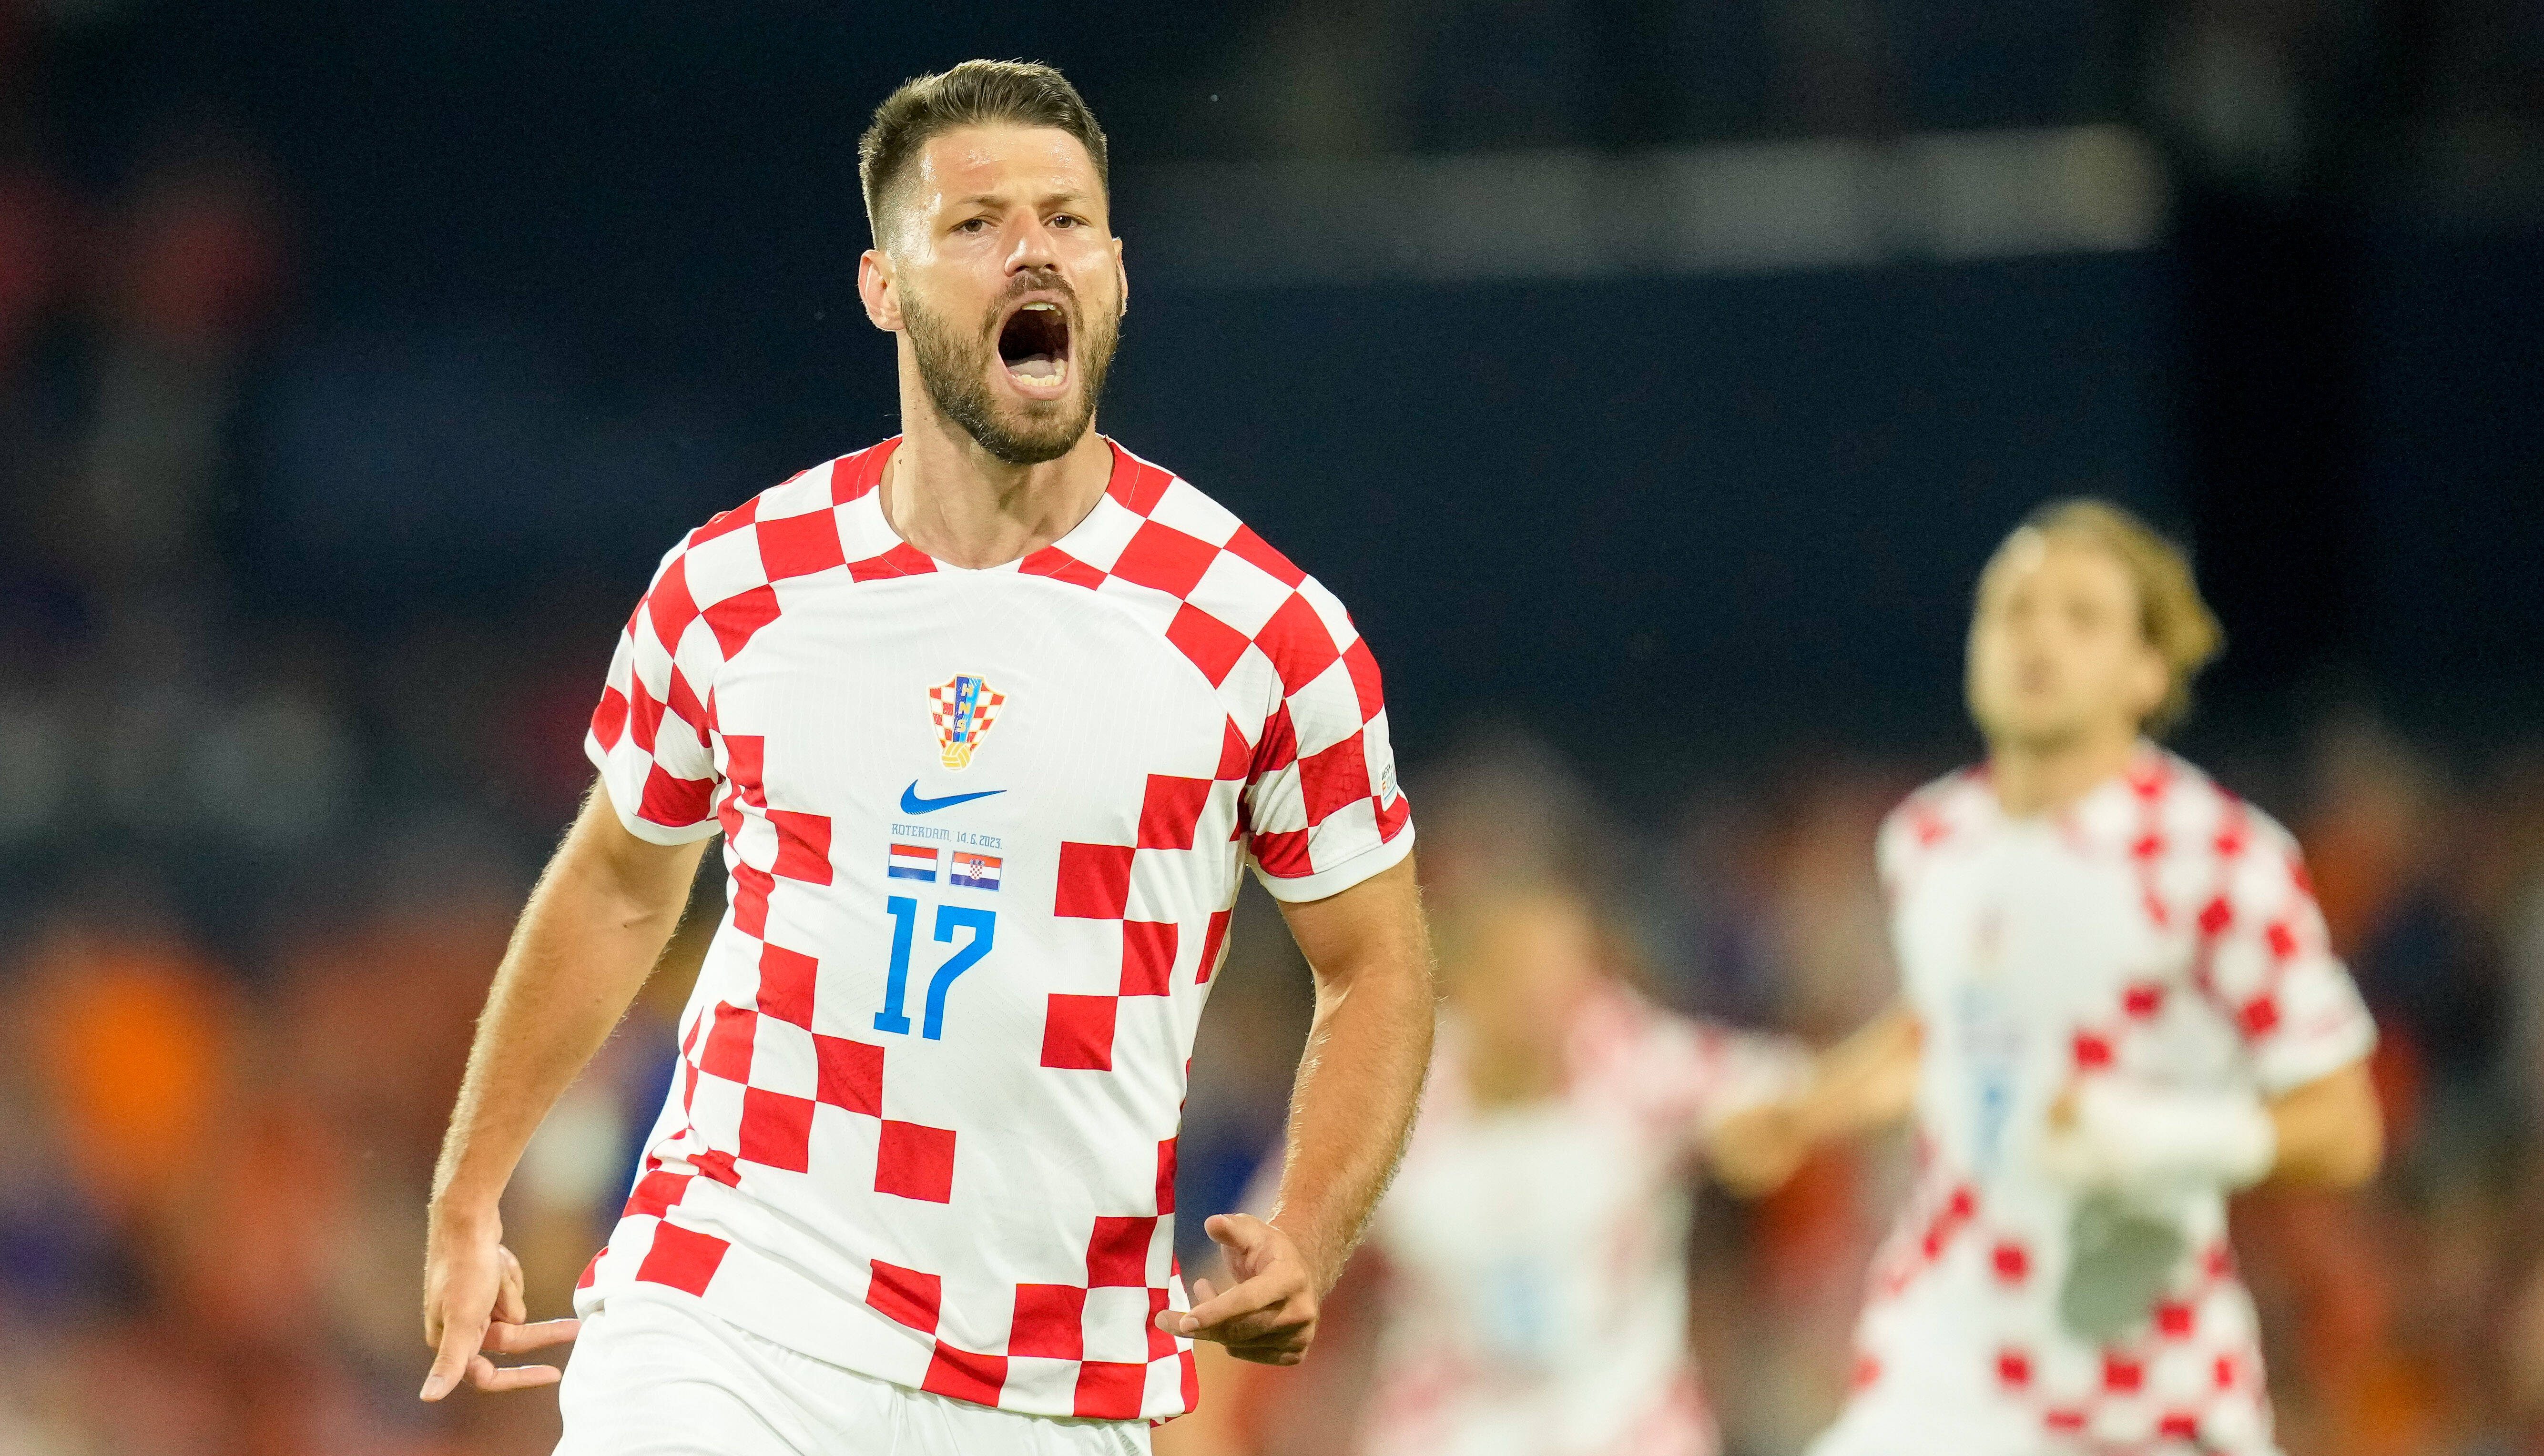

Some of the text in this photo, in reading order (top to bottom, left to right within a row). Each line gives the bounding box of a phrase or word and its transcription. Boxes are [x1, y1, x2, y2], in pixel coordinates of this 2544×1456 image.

[957, 683, 974, 733] HNS
[892, 823, 952, 842] ROTERDAM,
[874, 896, 997, 1041] 17
